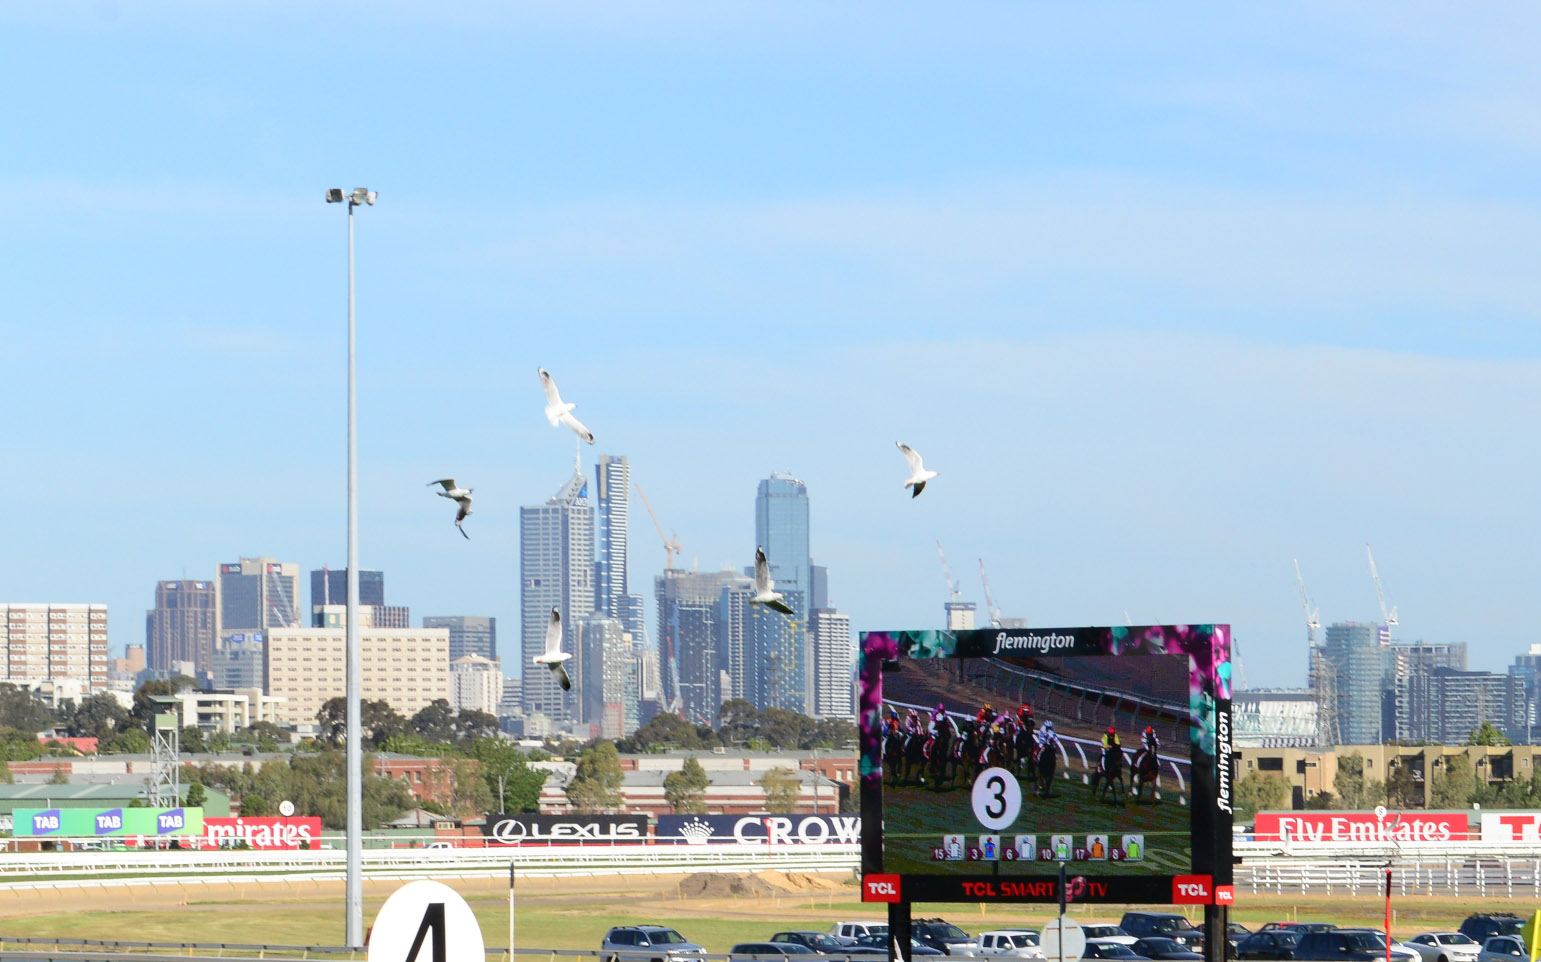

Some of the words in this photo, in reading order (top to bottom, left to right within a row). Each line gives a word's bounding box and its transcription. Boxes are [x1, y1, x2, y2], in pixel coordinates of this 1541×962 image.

[993, 631, 1075, 654] flemington
[1216, 711, 1230, 815] flemington
[984, 775, 1008, 819] 3
[34, 816, 59, 828] TAB
[97, 816, 121, 828] TAB
[158, 815, 184, 827] TAB
[190, 818, 311, 848] mirates
[532, 824, 640, 838] LEXUS
[1279, 817, 1324, 842] Fly
[1330, 817, 1450, 842] Emirates
[934, 849, 944, 859] 15
[971, 849, 978, 859] 3
[1006, 849, 1013, 859] 6
[1042, 849, 1051, 859] 10
[1075, 849, 1085, 859] 17
[1112, 848, 1119, 860] 8
[868, 882, 896, 895] TCL
[962, 882, 996, 896] TCL
[1001, 882, 1054, 896] SMART
[1089, 882, 1108, 896] TV
[1178, 883, 1207, 897] TCL
[1218, 890, 1232, 900] TCL
